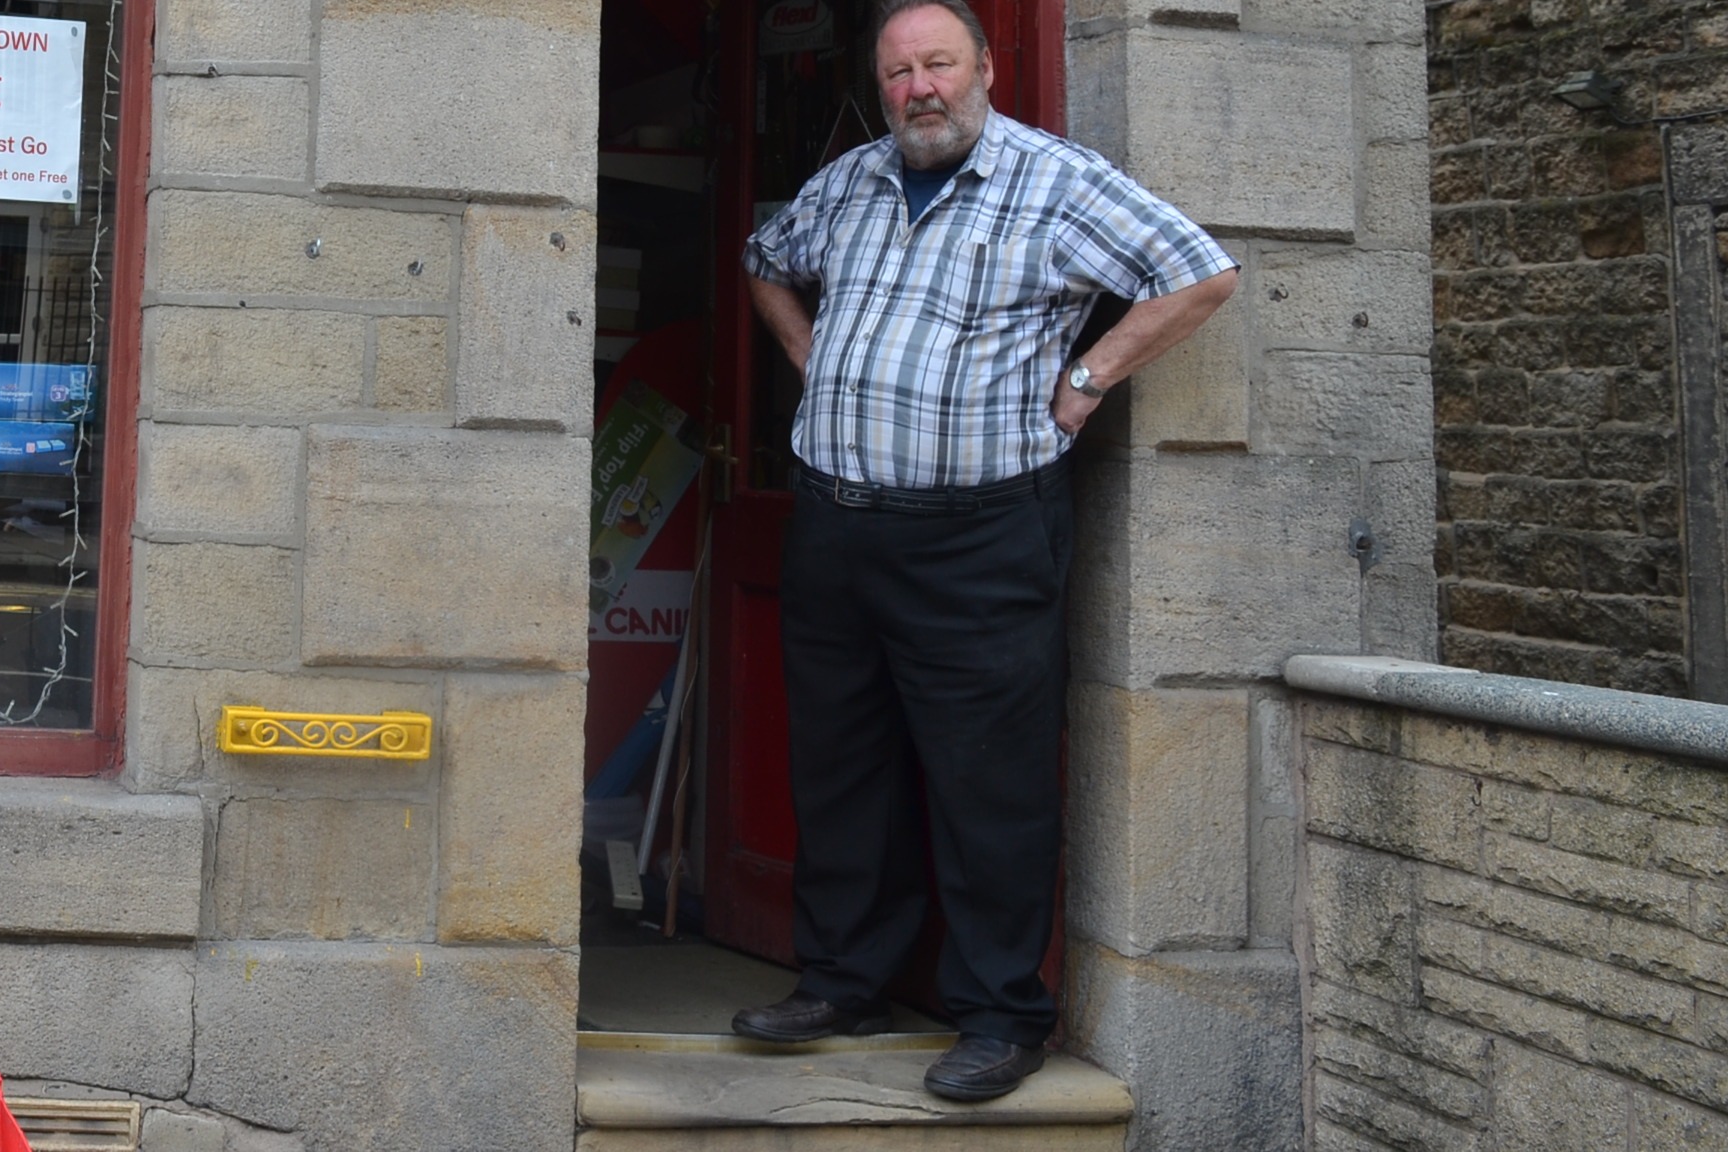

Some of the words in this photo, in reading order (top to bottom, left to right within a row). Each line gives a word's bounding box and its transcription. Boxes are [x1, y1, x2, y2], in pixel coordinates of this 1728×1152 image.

[21, 136, 47, 155] Go
[12, 171, 35, 182] one
[39, 170, 68, 184] Free
[605, 606, 690, 637] CANI
